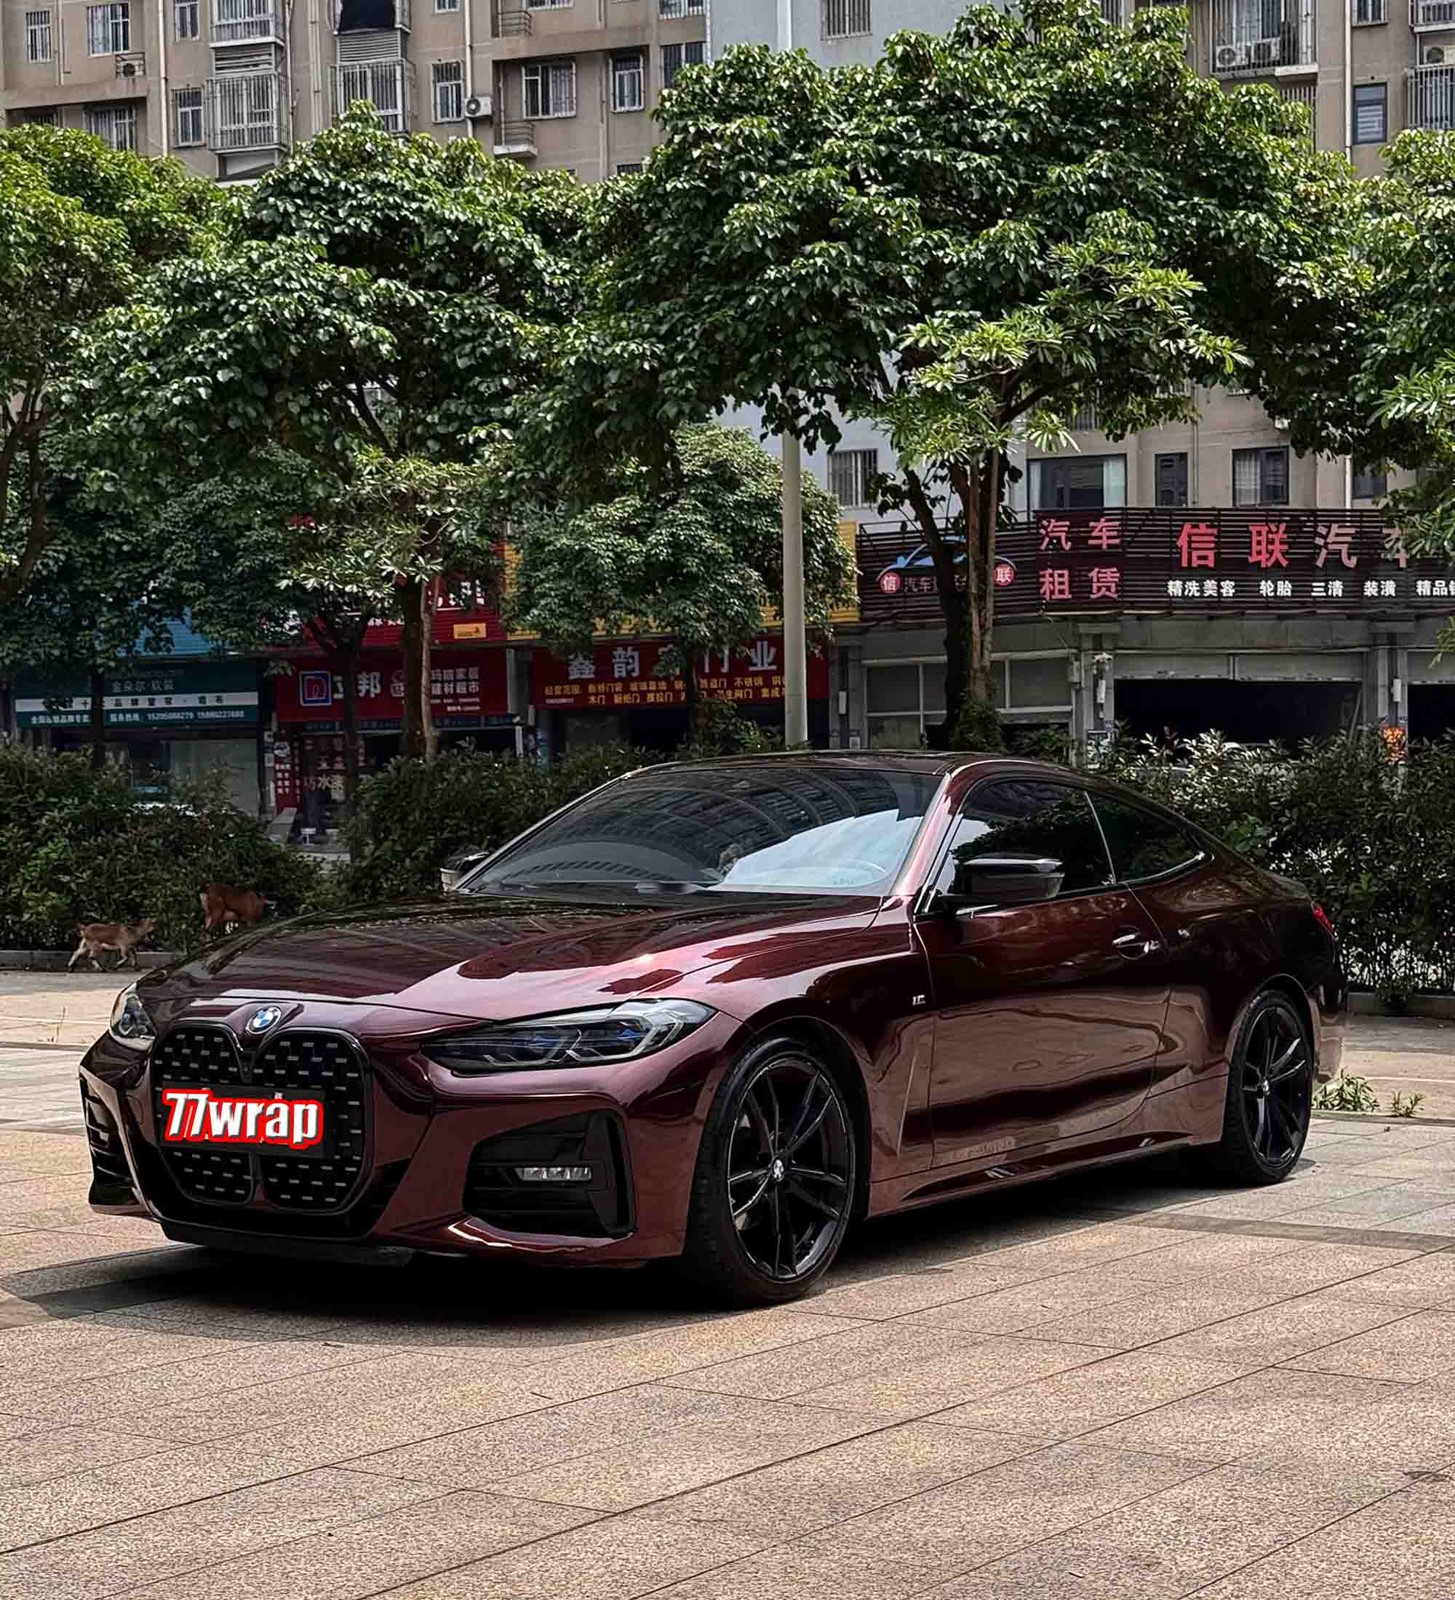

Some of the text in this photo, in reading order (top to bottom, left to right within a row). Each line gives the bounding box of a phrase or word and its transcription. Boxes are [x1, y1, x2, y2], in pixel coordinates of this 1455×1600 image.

[1039, 517, 1122, 552] 汽车
[881, 575, 898, 592] 信
[995, 566, 1014, 584] 联
[1039, 566, 1121, 601] 租赁
[1167, 579, 1236, 598] 精洗美容
[1259, 579, 1293, 598] 轮胎
[1311, 579, 1344, 598] 三清
[1363, 579, 1397, 598] 装潢
[430, 681, 480, 696] 建材超市
